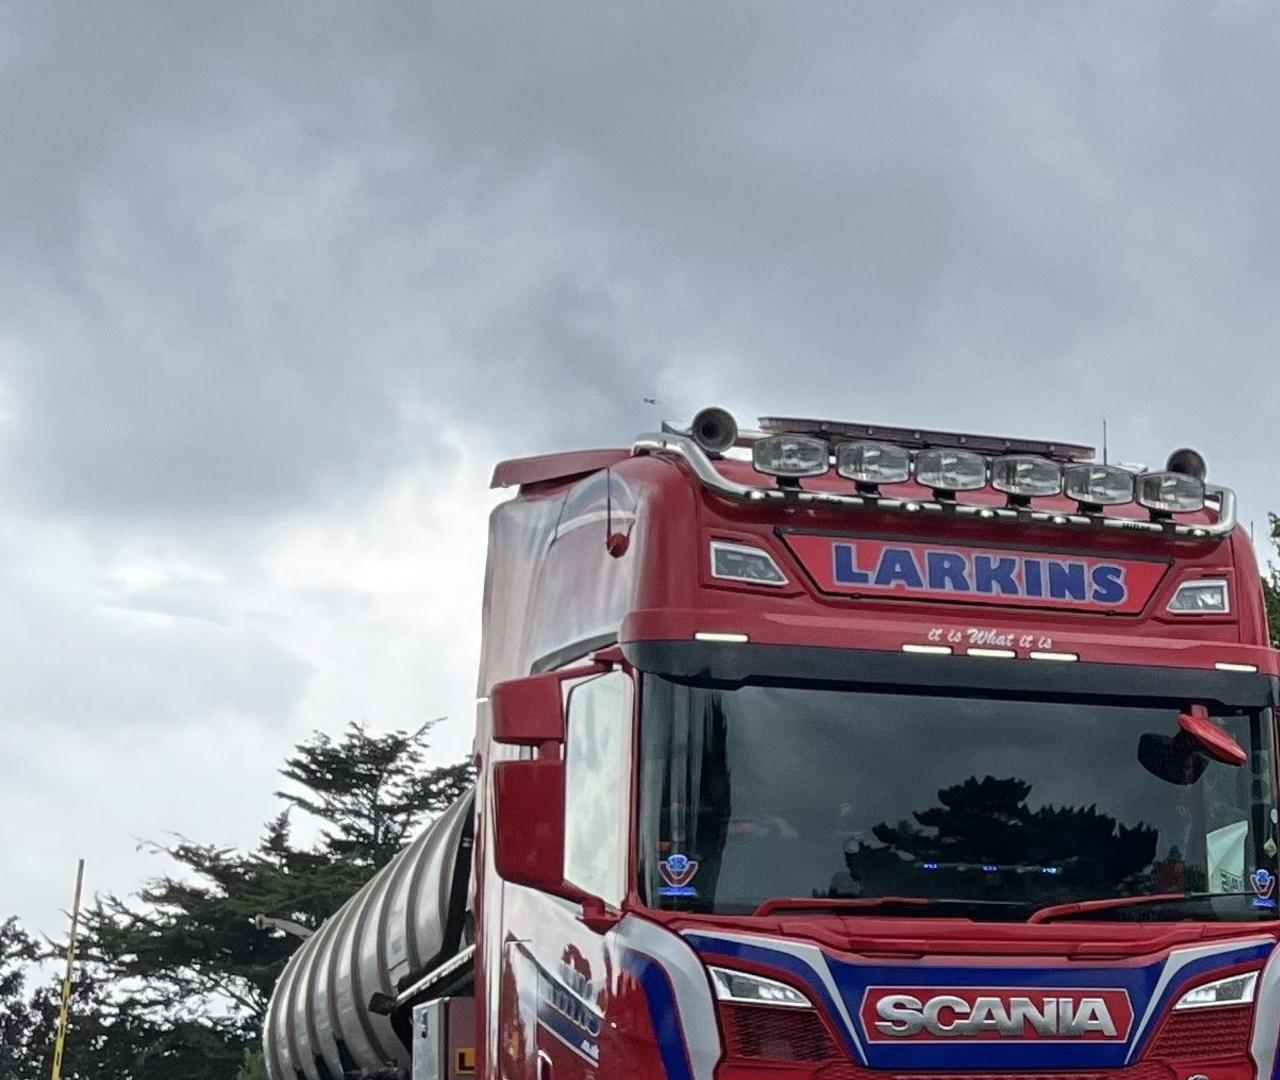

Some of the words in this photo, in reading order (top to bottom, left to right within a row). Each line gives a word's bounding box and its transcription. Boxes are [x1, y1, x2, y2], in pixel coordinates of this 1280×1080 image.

[832, 542, 1128, 606] LARKINS
[927, 628, 943, 642] it
[947, 629, 962, 643] is
[966, 628, 1015, 647] What
[1019, 634, 1034, 648] it
[1038, 635, 1052, 649] is
[875, 994, 1118, 1037] SCANIA
